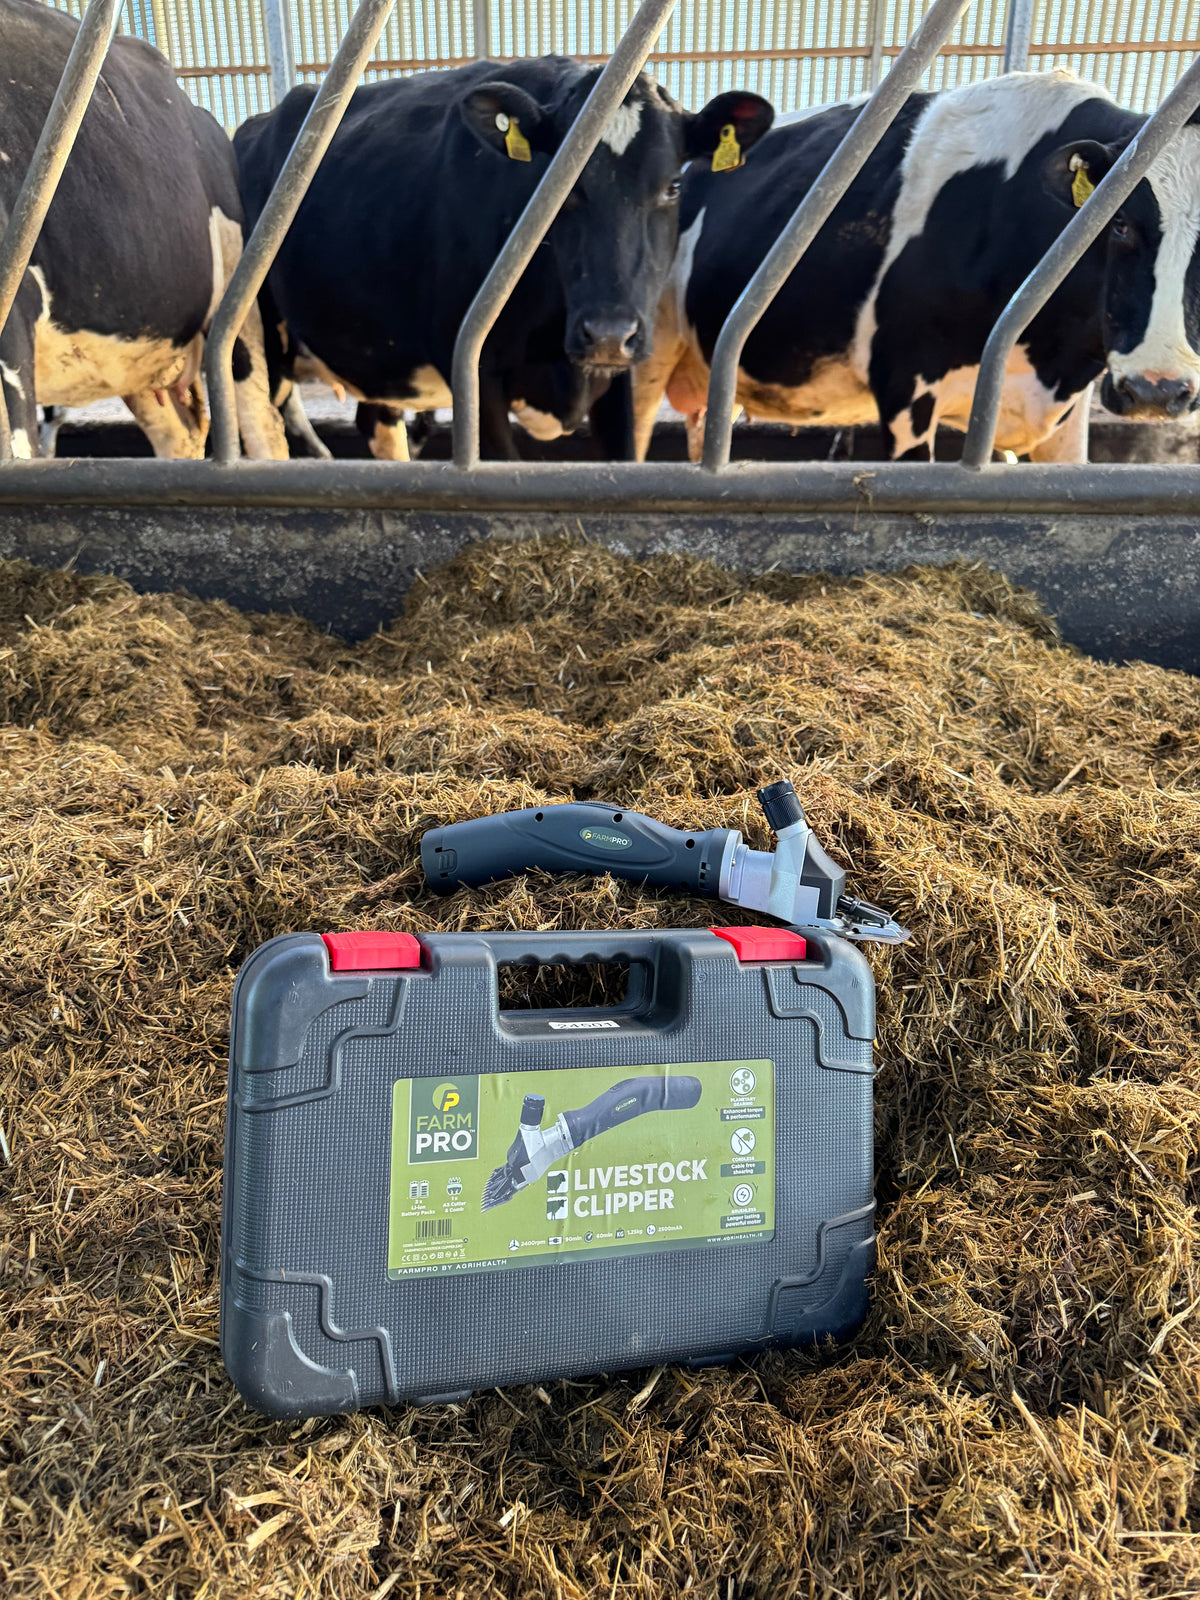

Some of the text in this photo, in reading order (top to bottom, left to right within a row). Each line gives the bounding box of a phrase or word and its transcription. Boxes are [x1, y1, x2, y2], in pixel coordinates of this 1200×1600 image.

[592, 832, 628, 846] FARMPRO
[416, 1112, 472, 1132] FARM
[416, 1130, 472, 1154] PRO
[573, 1159, 708, 1191] LIVESTOCK
[573, 1188, 675, 1218] CLIPPER
[726, 1220, 747, 1228] powerful
[398, 1266, 438, 1275] FARMPRO
[456, 1259, 507, 1270] AGRIHEALTH
